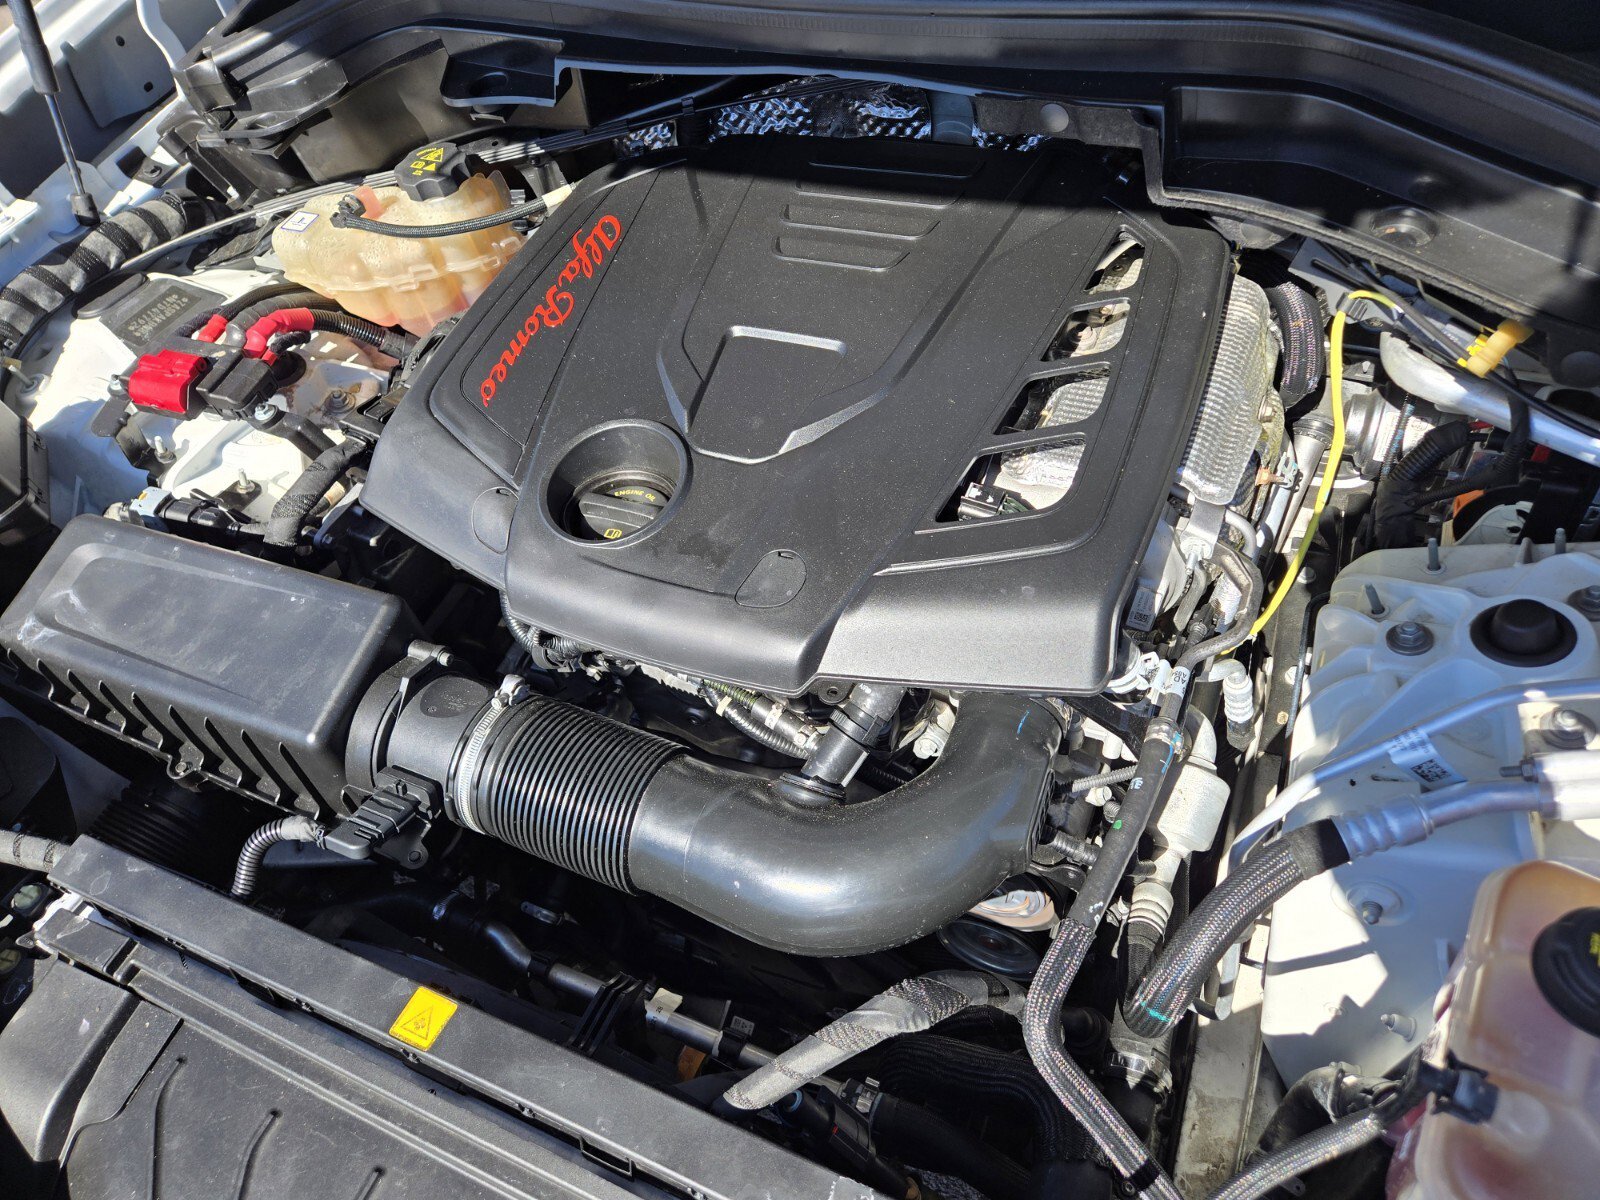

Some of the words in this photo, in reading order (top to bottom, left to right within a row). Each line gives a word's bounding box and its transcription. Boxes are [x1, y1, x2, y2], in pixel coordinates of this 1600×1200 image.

[558, 214, 622, 287] Alfa
[480, 285, 575, 408] Romeo
[614, 489, 645, 497] ENGINE
[644, 493, 656, 502] OIL
